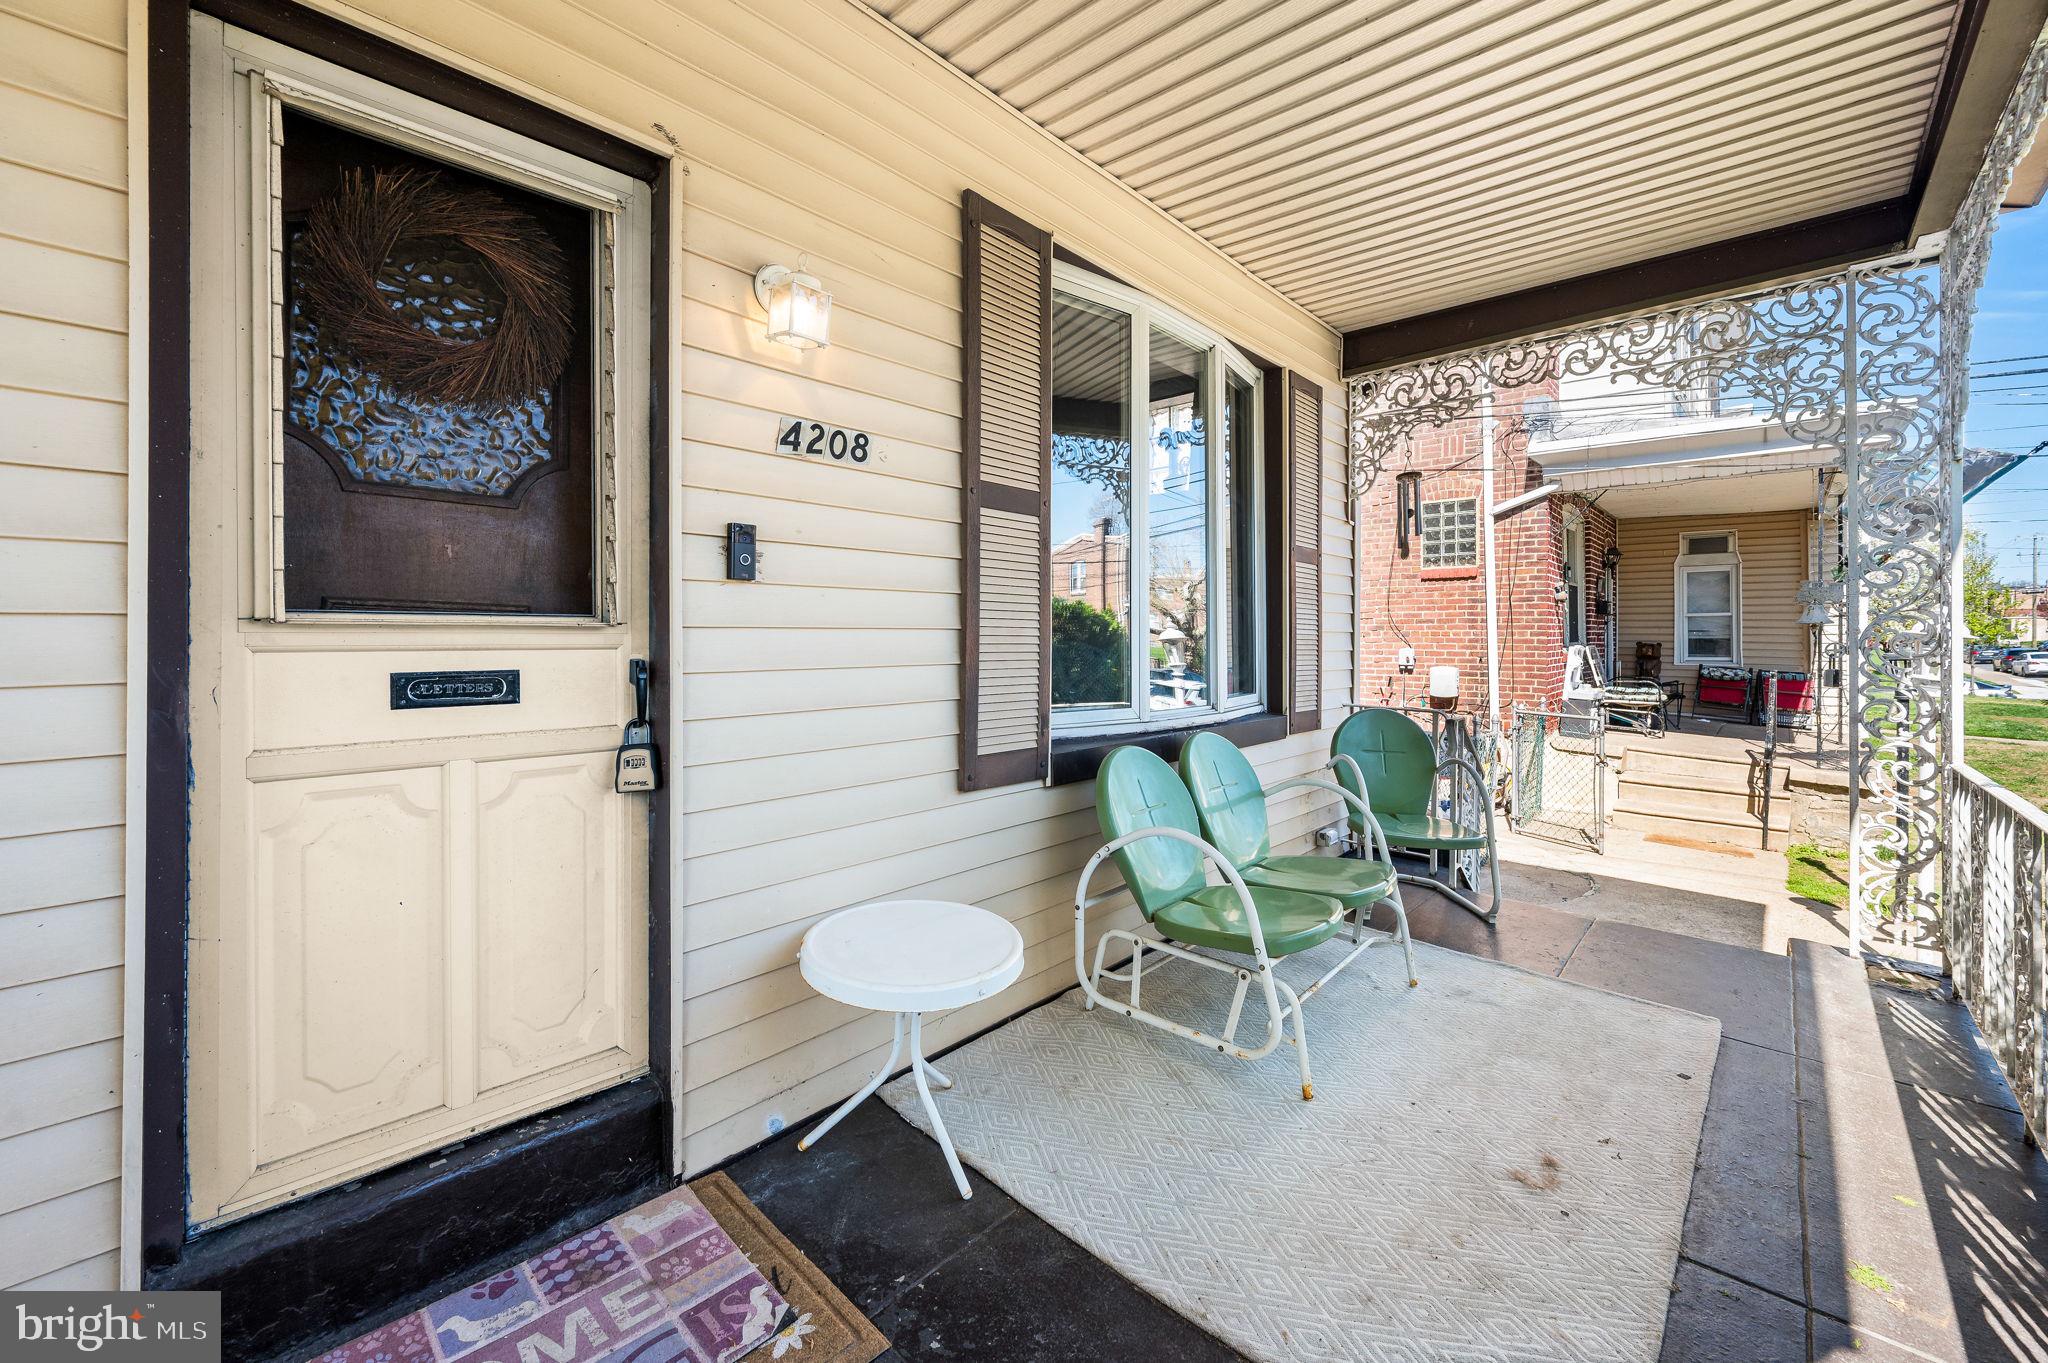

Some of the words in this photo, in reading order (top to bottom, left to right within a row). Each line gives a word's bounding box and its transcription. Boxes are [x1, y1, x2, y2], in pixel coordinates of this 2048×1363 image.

[779, 420, 869, 463] 4208
[420, 682, 494, 696] LETTERS
[481, 1278, 663, 1363] ME
[692, 1289, 758, 1345] IS
